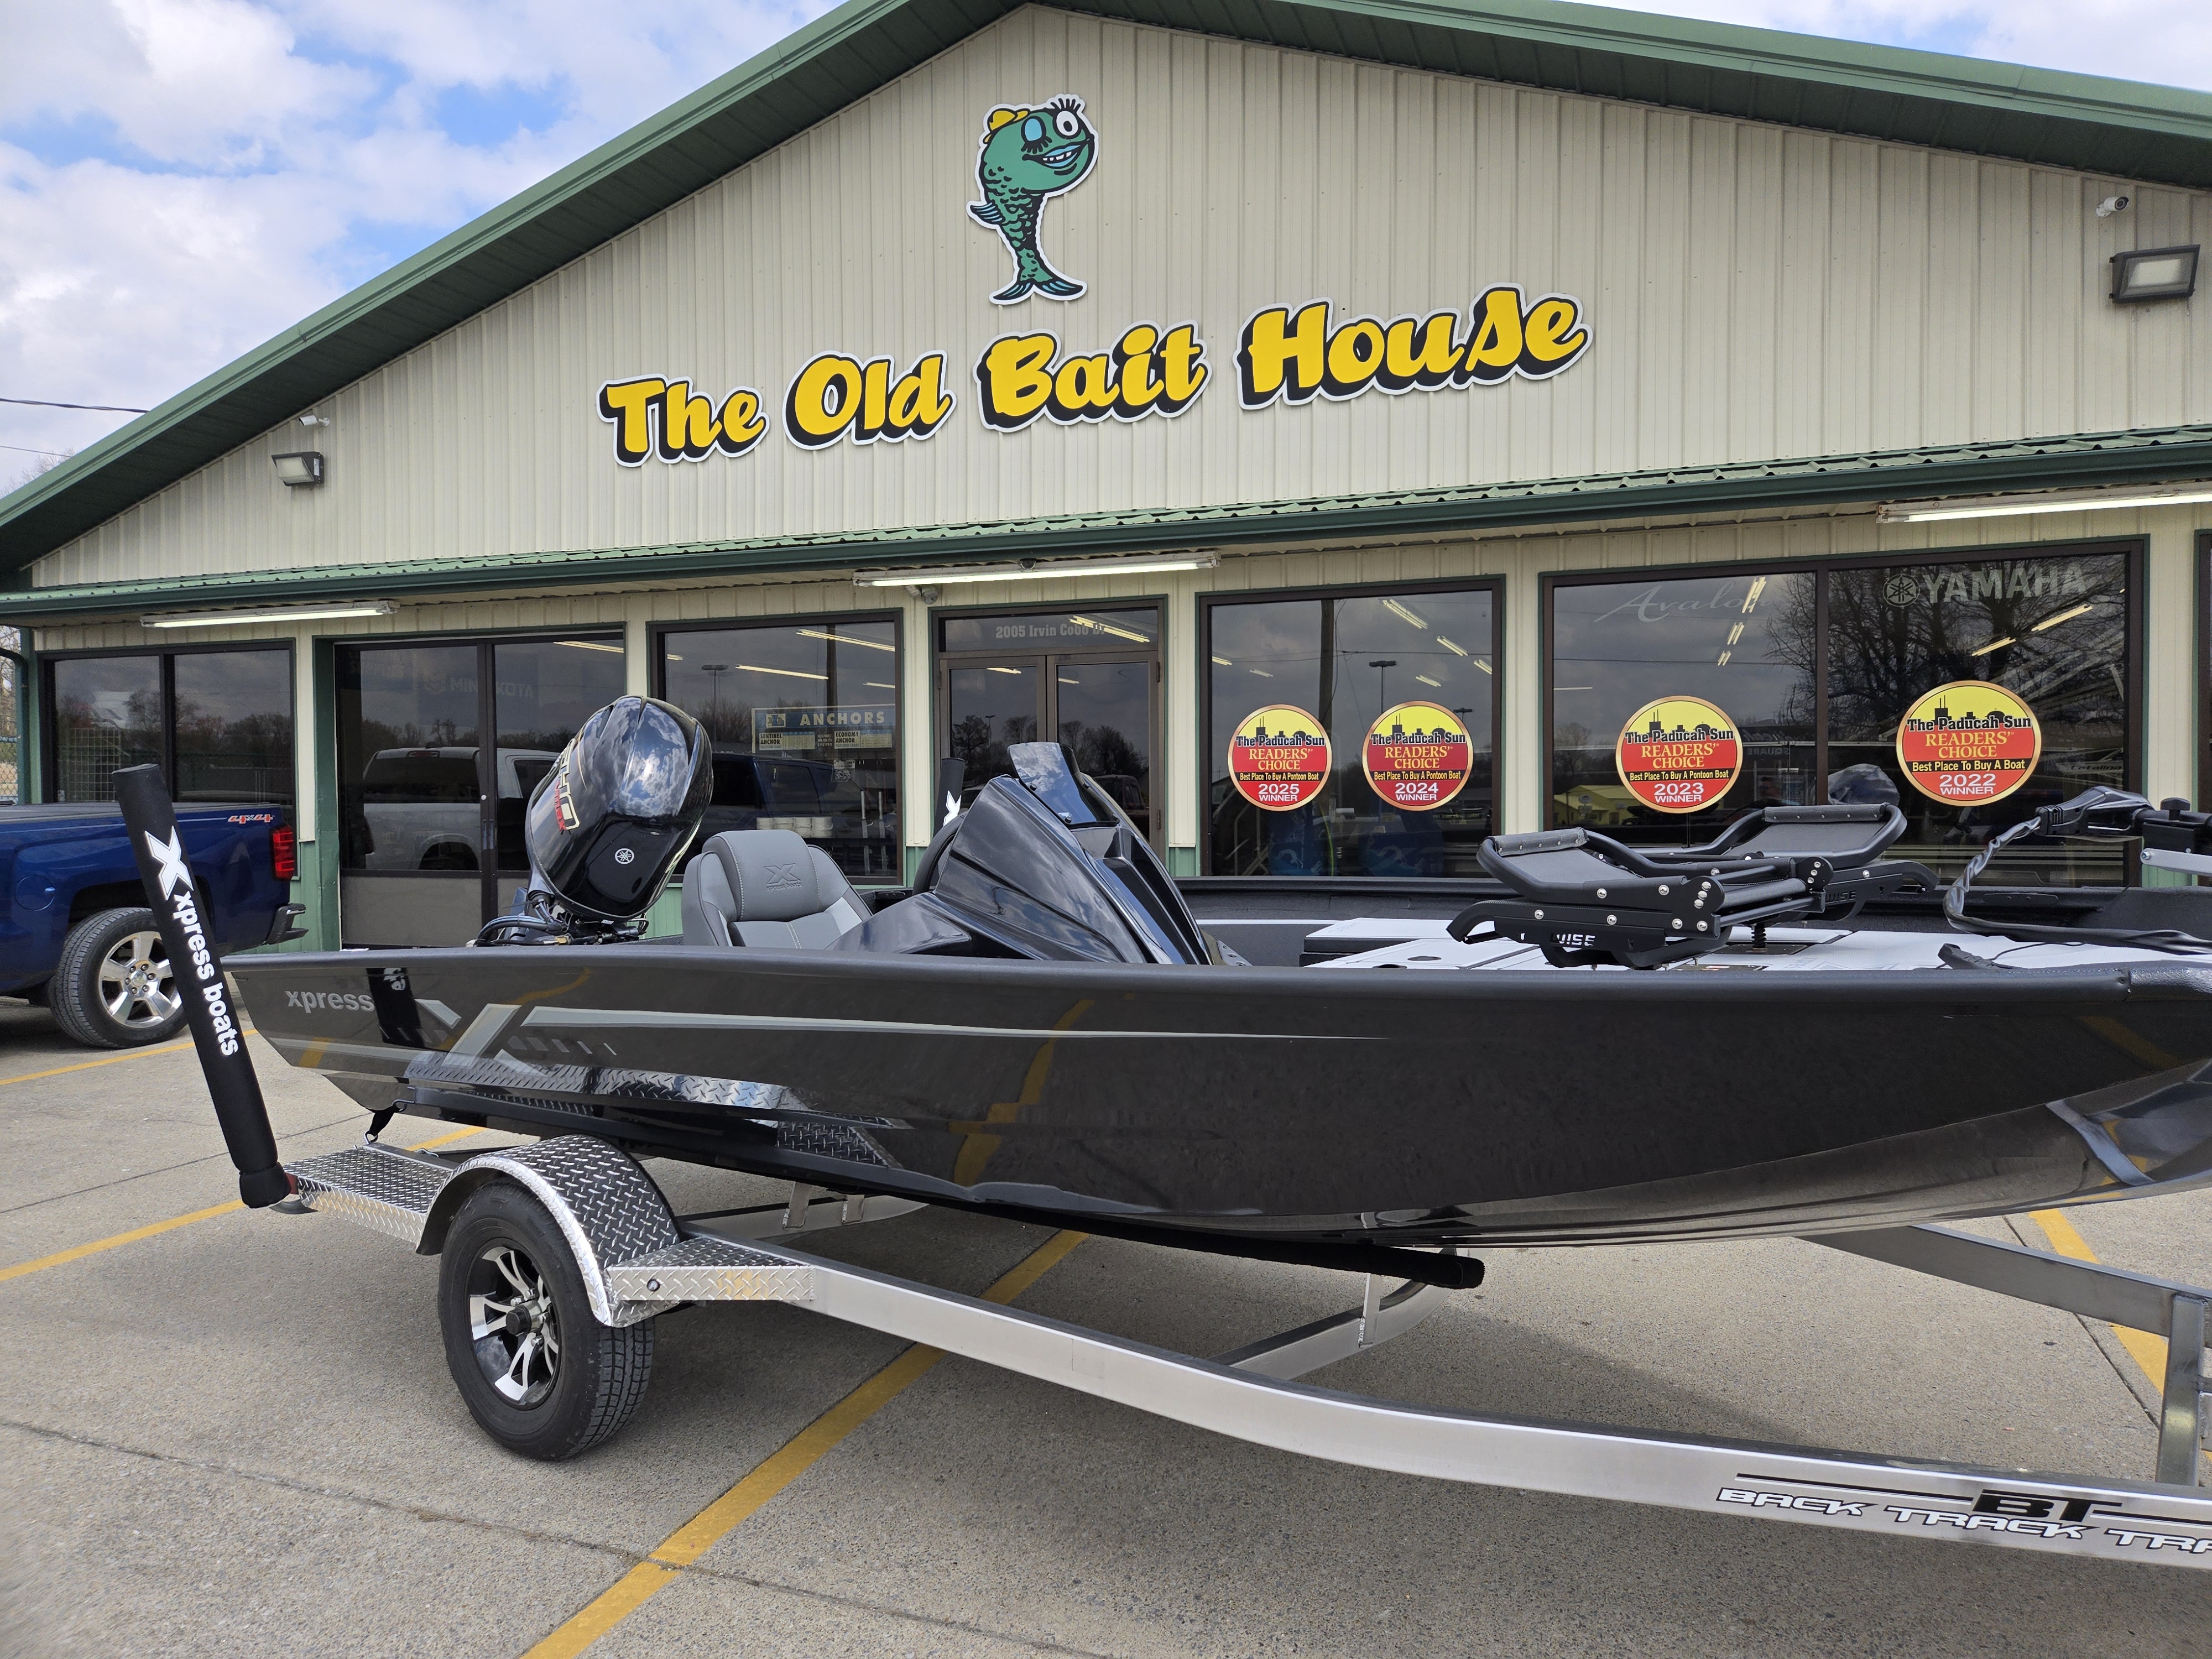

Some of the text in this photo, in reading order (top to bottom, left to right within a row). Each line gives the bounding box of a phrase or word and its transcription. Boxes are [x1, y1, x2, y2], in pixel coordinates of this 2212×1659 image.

[599, 286, 1590, 463] The Old Bait House
[1923, 564, 2088, 603] YAMAHA
[996, 625, 1025, 638] 2005
[1029, 624, 1056, 637] Irvin
[1060, 623, 1089, 635] Cobb
[800, 711, 885, 726] ANCHORS
[1907, 715, 2032, 732] The Paducah Sun
[1237, 734, 1325, 746] The Paducah Sun
[1371, 732, 1466, 745] The Paducah Sun
[1625, 732, 1649, 744] The
[1652, 728, 1705, 743] Paducah
[1709, 728, 1734, 740] Sun
[1938, 745, 1997, 759] CHOICE
[1258, 760, 1300, 770] CHOICE
[1395, 758, 1439, 769] CHOICE
[1652, 756, 1704, 769] CHOICE
[1912, 759, 2025, 771] Best Place To Buy A Boat
[1272, 773, 1281, 781] Buy
[1387, 771, 1400, 780] Place
[1402, 771, 1408, 780] To
[1410, 771, 1420, 781] Buy
[1448, 771, 1460, 779] Boat
[1661, 771, 1668, 780] To
[1671, 771, 1682, 781] Buy
[1683, 771, 1688, 779] A
[1689, 770, 1713, 779] Pontoon
[1715, 770, 1729, 778] Boat
[1939, 774, 1996, 787] 2022
[1258, 784, 1299, 795] 2025
[1395, 782, 1438, 794] 2024
[1654, 782, 1704, 796] 2023
[1825, 891, 1857, 904] WISE
[1551, 933, 1595, 947] WISE
[173, 891, 238, 1056] xpress boats
[285, 990, 375, 1014] xpress
[1973, 1489, 2122, 1522] BT
[1716, 1487, 1879, 1516] BACK
[1884, 1505, 2100, 1540] TRACK
